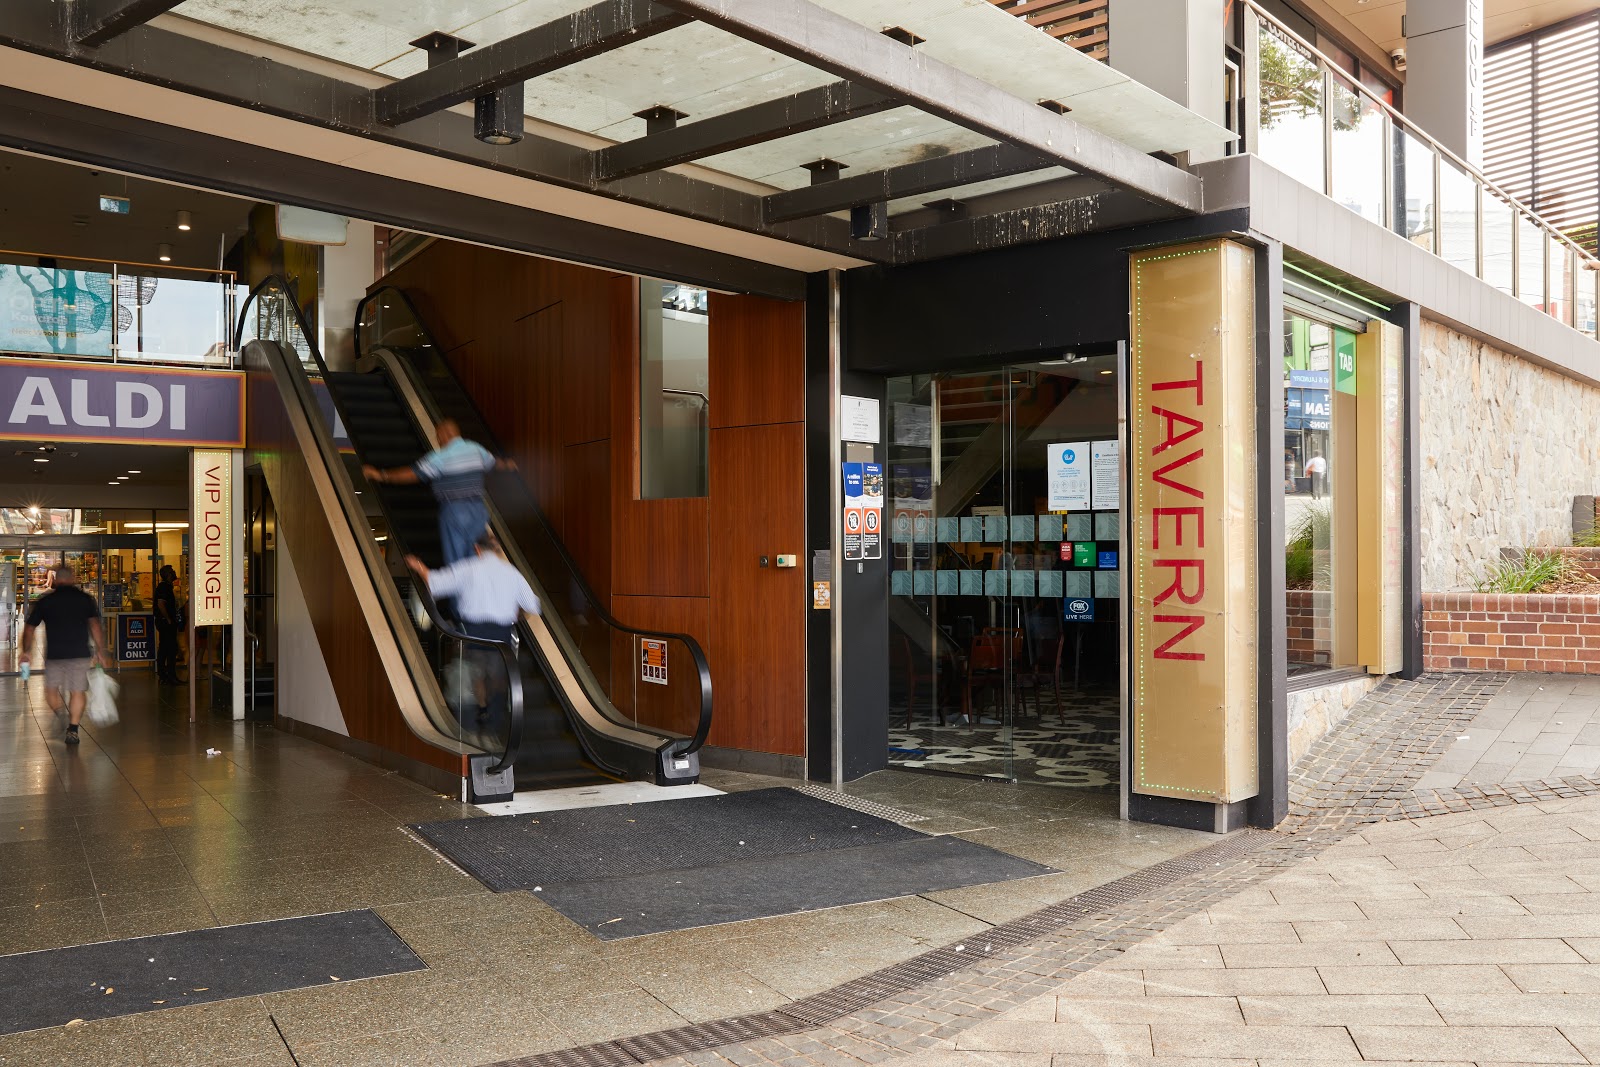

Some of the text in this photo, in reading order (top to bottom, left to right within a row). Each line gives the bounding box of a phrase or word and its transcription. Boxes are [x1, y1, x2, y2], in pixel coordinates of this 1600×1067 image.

[1339, 352, 1353, 372] TAB
[8, 376, 186, 430] ALDI
[1152, 360, 1205, 661] TAVERN
[205, 465, 221, 610] VIP LOUNGE
[125, 650, 149, 659] ONLY
[127, 641, 147, 649] EXIT
